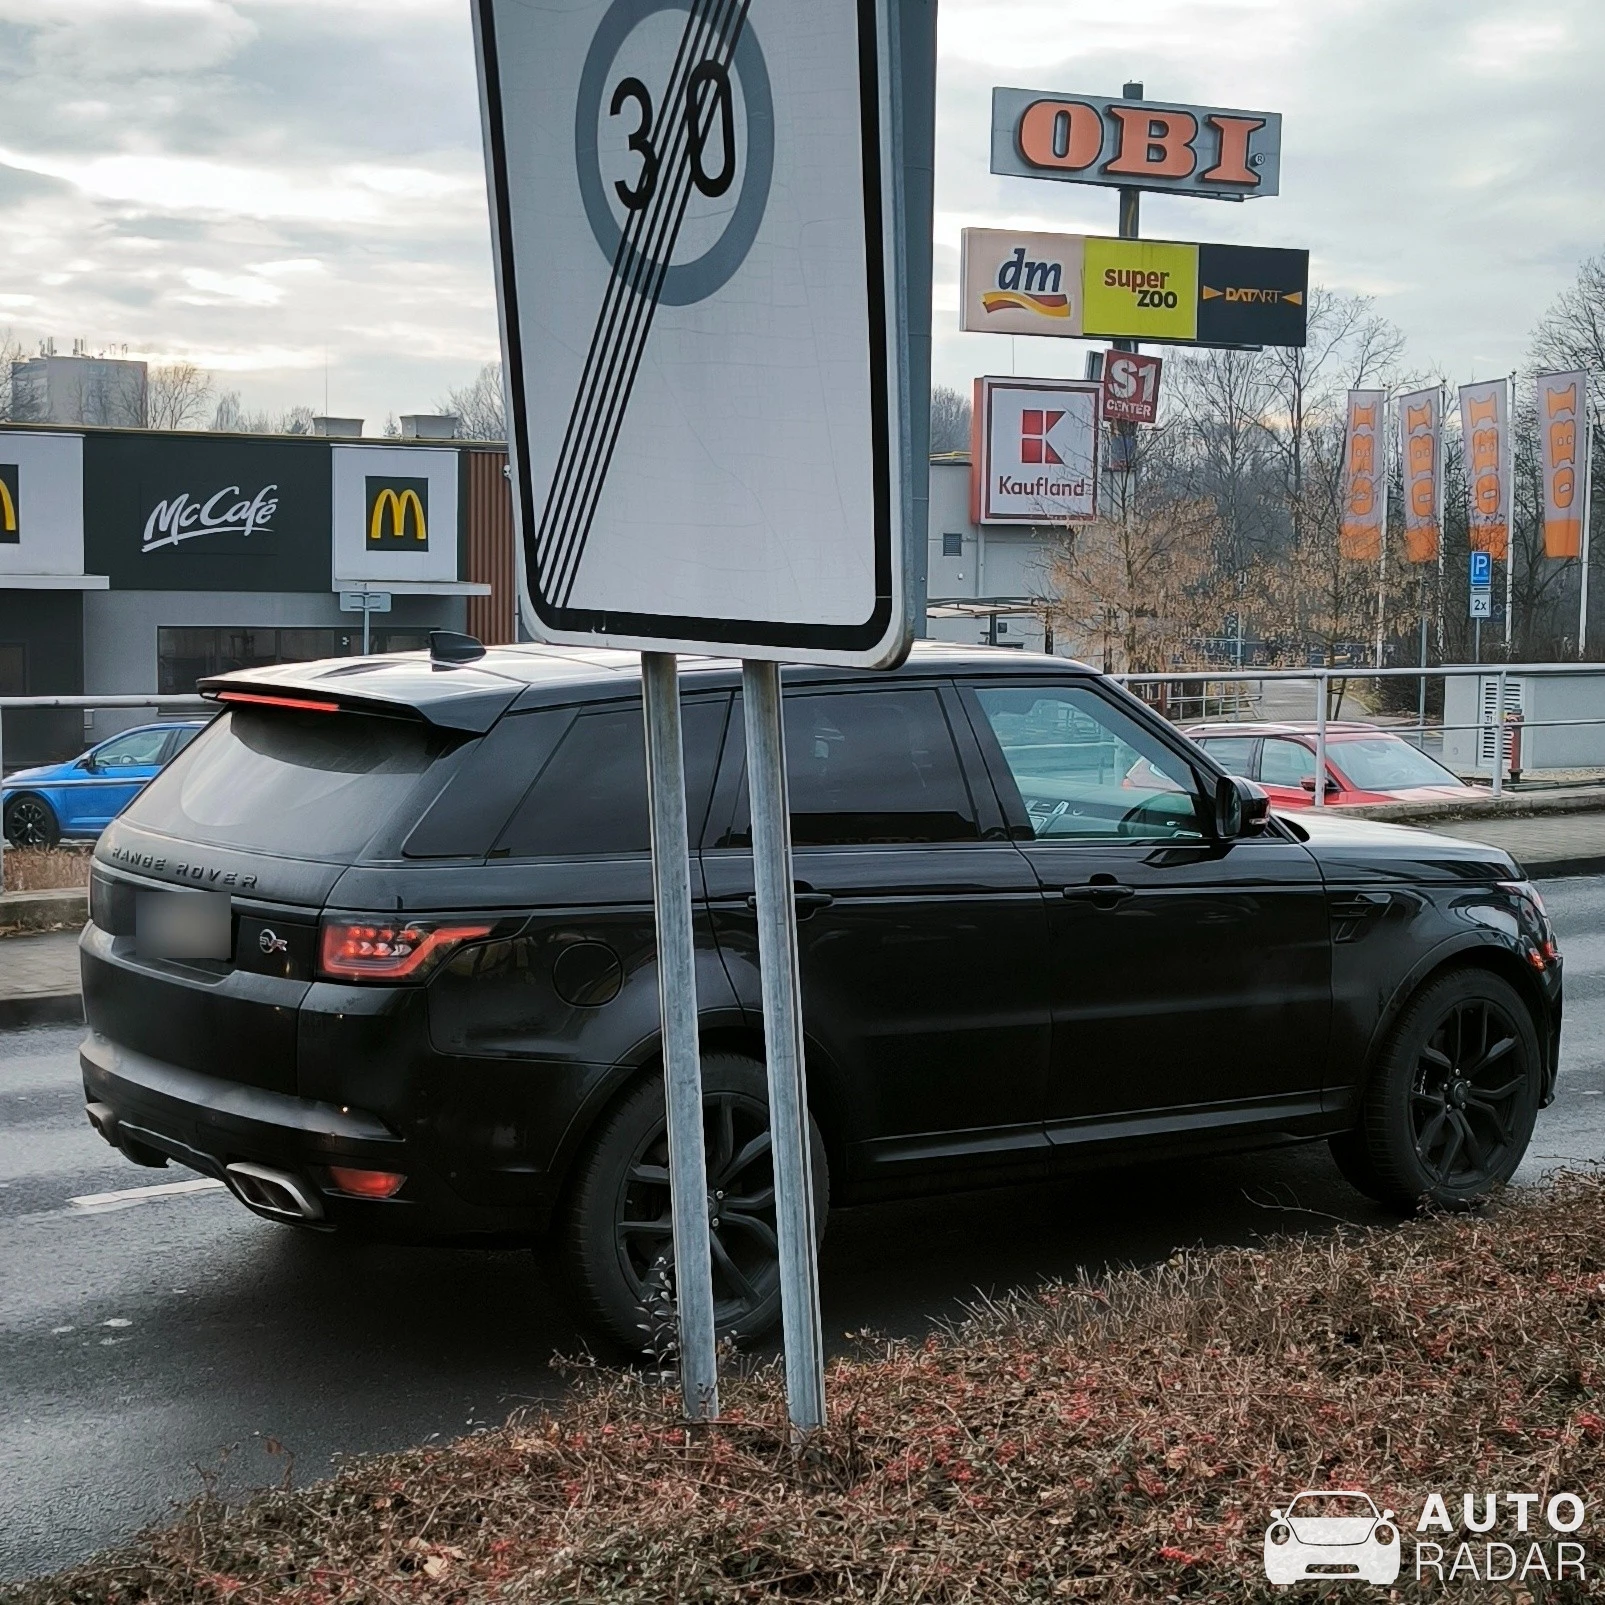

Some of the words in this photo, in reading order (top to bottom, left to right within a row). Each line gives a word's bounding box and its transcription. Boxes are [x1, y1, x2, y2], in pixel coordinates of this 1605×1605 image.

[609, 59, 736, 210] 30
[1018, 99, 1266, 185] OBI
[998, 248, 1062, 292] dm
[1104, 267, 1170, 292] super
[1136, 290, 1178, 309] zoo
[1225, 287, 1283, 304] DATART
[1107, 359, 1156, 402] S1
[1106, 399, 1151, 416] CENTER
[1351, 401, 1377, 516] OBI
[1470, 392, 1500, 514] OBI
[1546, 383, 1577, 508] OBI
[999, 476, 1085, 497] Kaufland
[142, 484, 279, 548] McCafé
[1475, 555, 1488, 575] P
[1474, 599, 1487, 611] 2x
[111, 847, 168, 871] RANGE
[176, 861, 258, 889] ROVER
